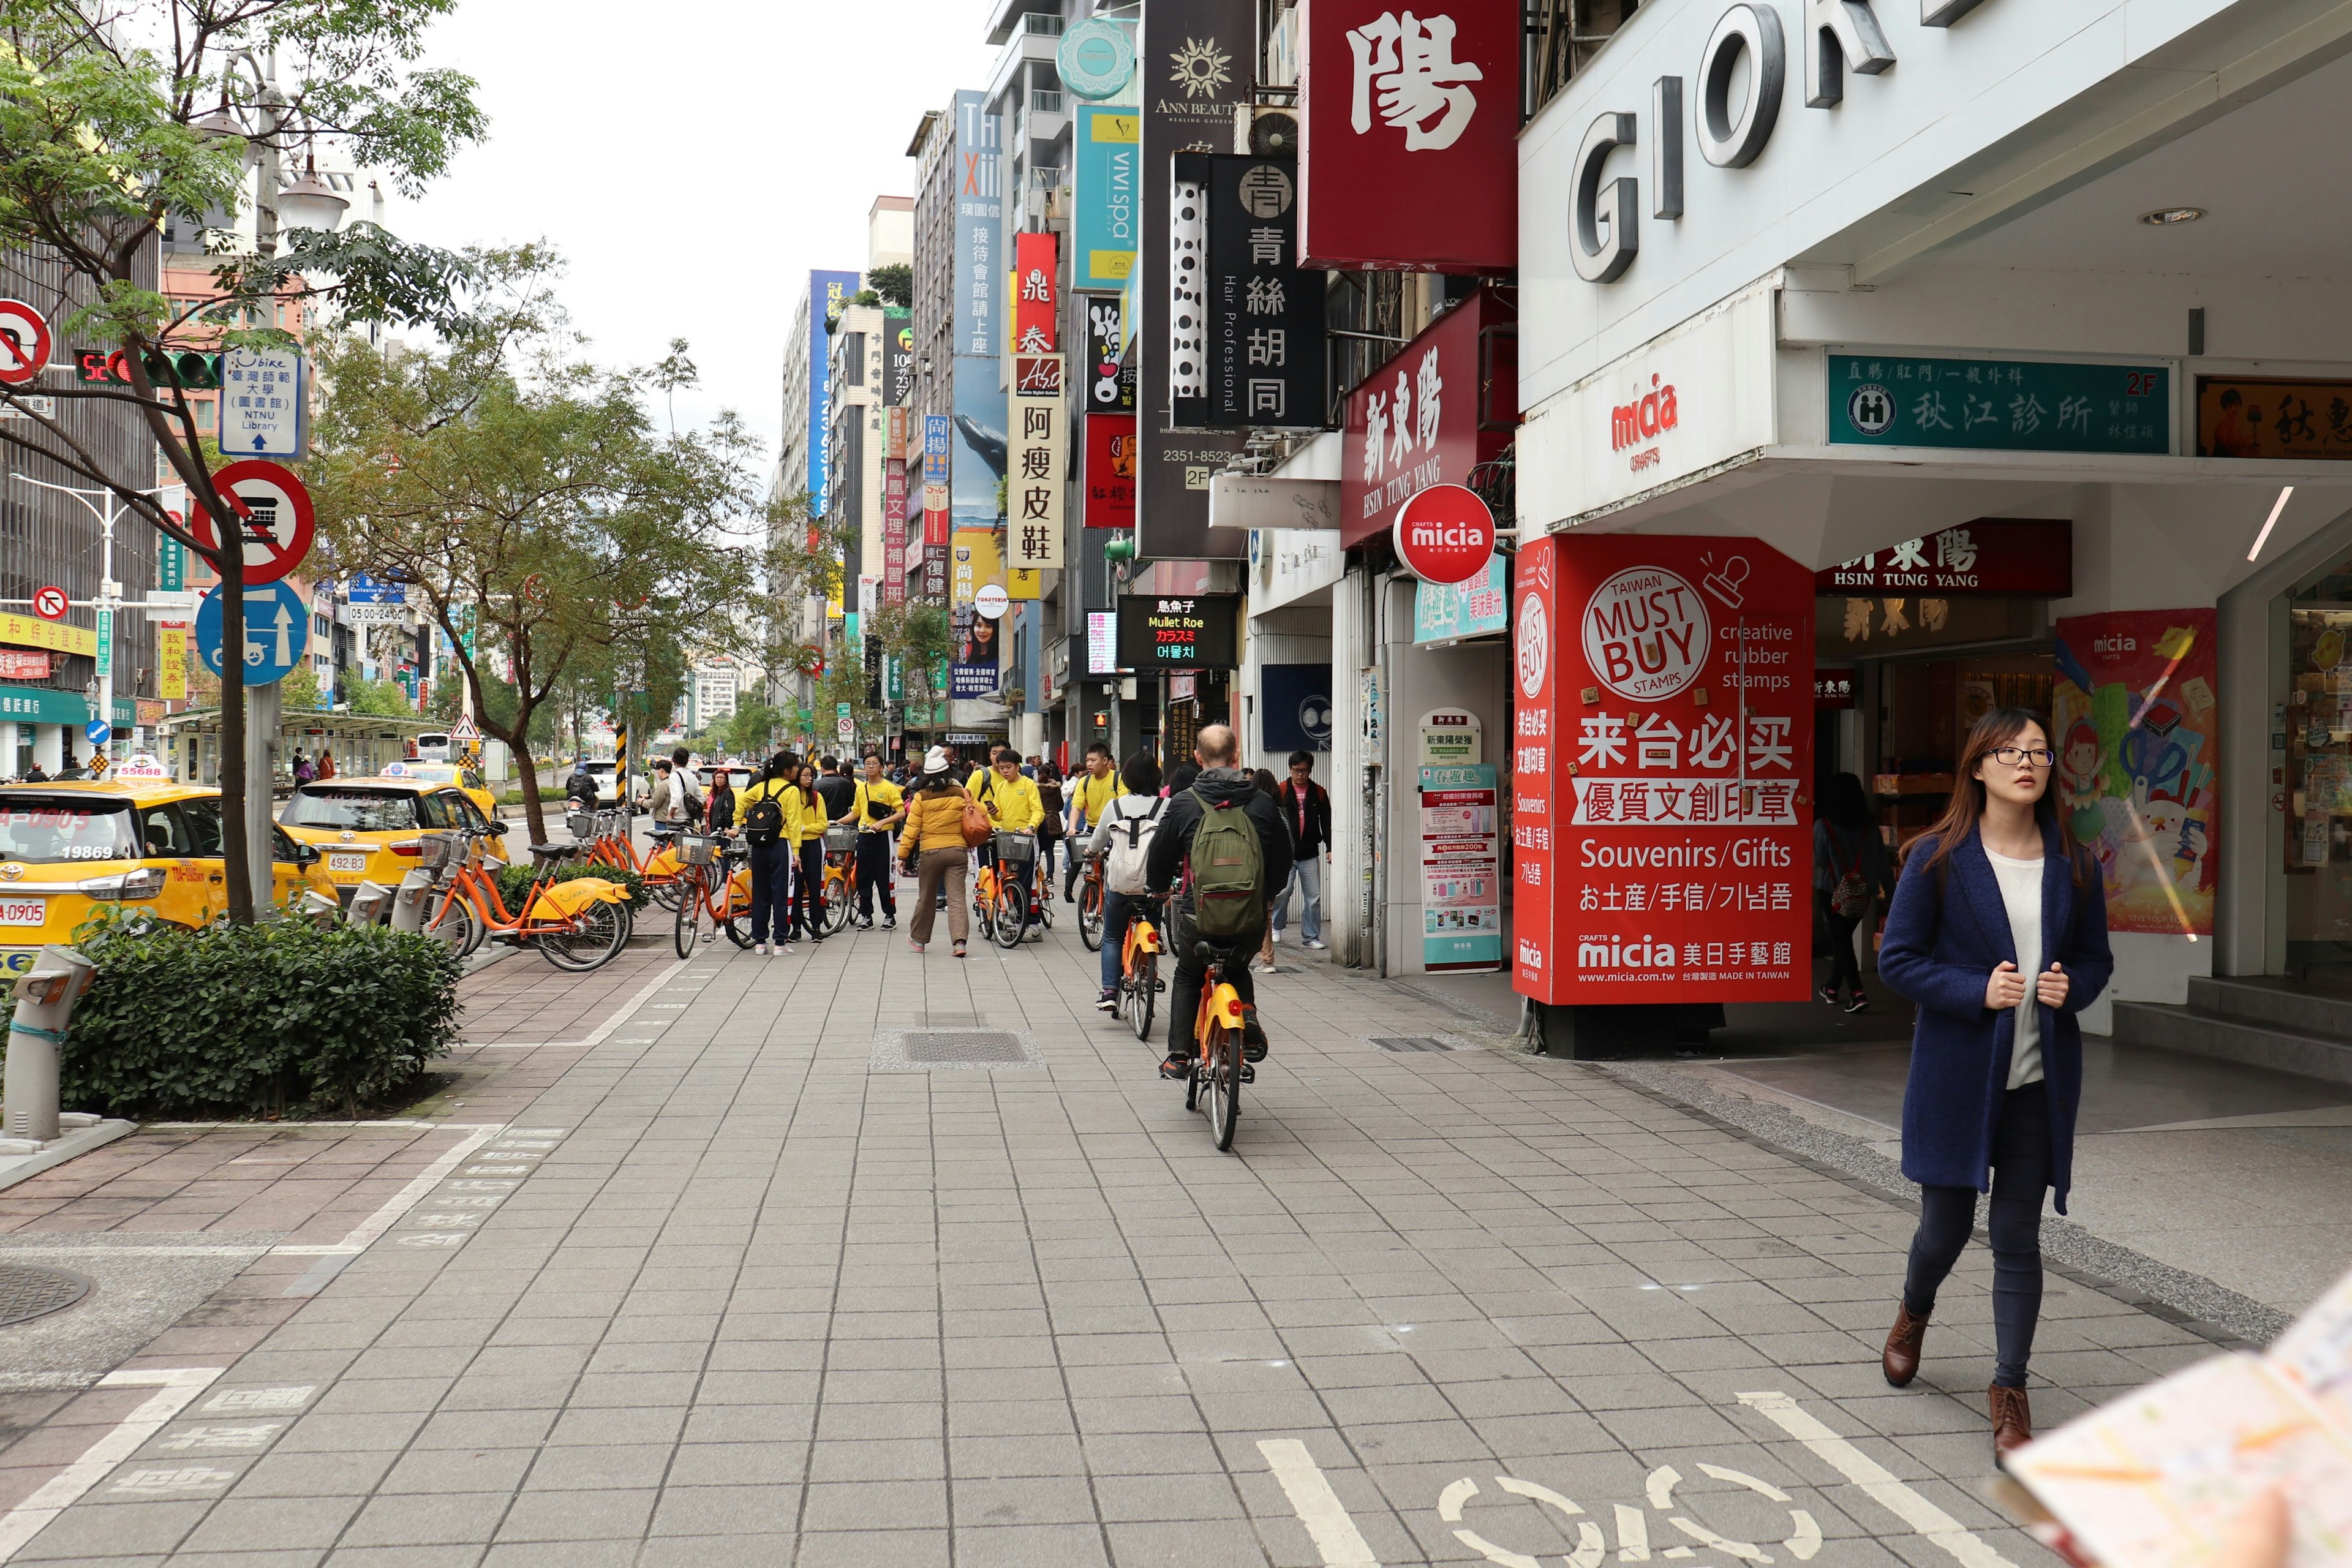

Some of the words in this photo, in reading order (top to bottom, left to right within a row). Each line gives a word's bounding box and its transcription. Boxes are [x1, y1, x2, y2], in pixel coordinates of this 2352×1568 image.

[1346, 10, 1483, 152] 陽
[1156, 99, 1189, 114] ANN
[961, 203, 1002, 218] 璞園信
[972, 227, 989, 353] 接待會館請上座
[1224, 276, 1237, 304] Hair
[1246, 227, 1286, 418] 青絲胡同
[83, 354, 108, 381] 52
[1224, 313, 1237, 412] Professional
[231, 370, 291, 383] 臺灣師範
[247, 383, 275, 396] 大學
[2126, 371, 2157, 397] 2F
[245, 411, 275, 420] NTNU
[1364, 345, 1442, 486] 新東陽
[1611, 372, 1678, 450] micia
[1912, 391, 2093, 438] 秋江診所
[242, 421, 277, 432] Library
[927, 418, 946, 454] 尚揚
[1163, 450, 1231, 462] 2351-8523
[1022, 407, 1054, 560] 阿瘦皮鞋
[1187, 471, 1208, 484] 2F
[1363, 486, 1384, 519] HSIN
[1386, 472, 1411, 508] TUNG
[1414, 454, 1441, 492] YANG
[1412, 522, 1483, 546] micia
[168, 537, 176, 586] 中國信託銀行
[926, 560, 944, 594] 復健
[956, 564, 974, 598] 尚揚
[1610, 575, 1662, 597] TAIWAN
[1834, 572, 1874, 586] HSIN
[1883, 573, 1928, 586] TUNG
[1936, 574, 1979, 587] YANG
[1157, 600, 1195, 613] 烏魚子
[1470, 588, 1502, 621] 美味食光
[1593, 586, 1686, 642] MUST
[1149, 617, 1180, 628] Mullet
[1183, 617, 1204, 628] Roe
[1519, 608, 1542, 652] MUST
[1720, 623, 1793, 641] creative
[1156, 630, 1194, 642] カラスミ
[2094, 633, 2137, 653] micia
[166, 633, 180, 684] 致和證券
[1521, 636, 1544, 684] BUY
[1602, 622, 1695, 684] BUY
[1725, 646, 1789, 664] rubber
[892, 658, 900, 693] 世界金牌
[1634, 672, 1682, 695] STAMPS
[1722, 671, 1790, 693] stamps
[1427, 734, 1473, 745] 新東陽榮獲
[1577, 710, 1793, 771] 来台必买
[121, 767, 161, 776] 55688
[1517, 745, 1547, 775] 文創印章
[1517, 793, 1545, 815] Souvenirs
[1582, 782, 1790, 823] 優質文創印章
[62, 846, 113, 859] 19869
[330, 858, 364, 869] 492-B3
[1521, 860, 1541, 887] 기념품
[1519, 940, 1542, 969] micia
[1578, 934, 1676, 968] micia
[1683, 941, 1792, 967] 美日手藝館
[1578, 971, 1675, 982] www.micia.com.tw
[1682, 971, 1717, 981] 台灣製造
[1719, 973, 1744, 981] MADE
[1746, 972, 1755, 981] IN
[1756, 971, 1790, 980] TAIWAN
